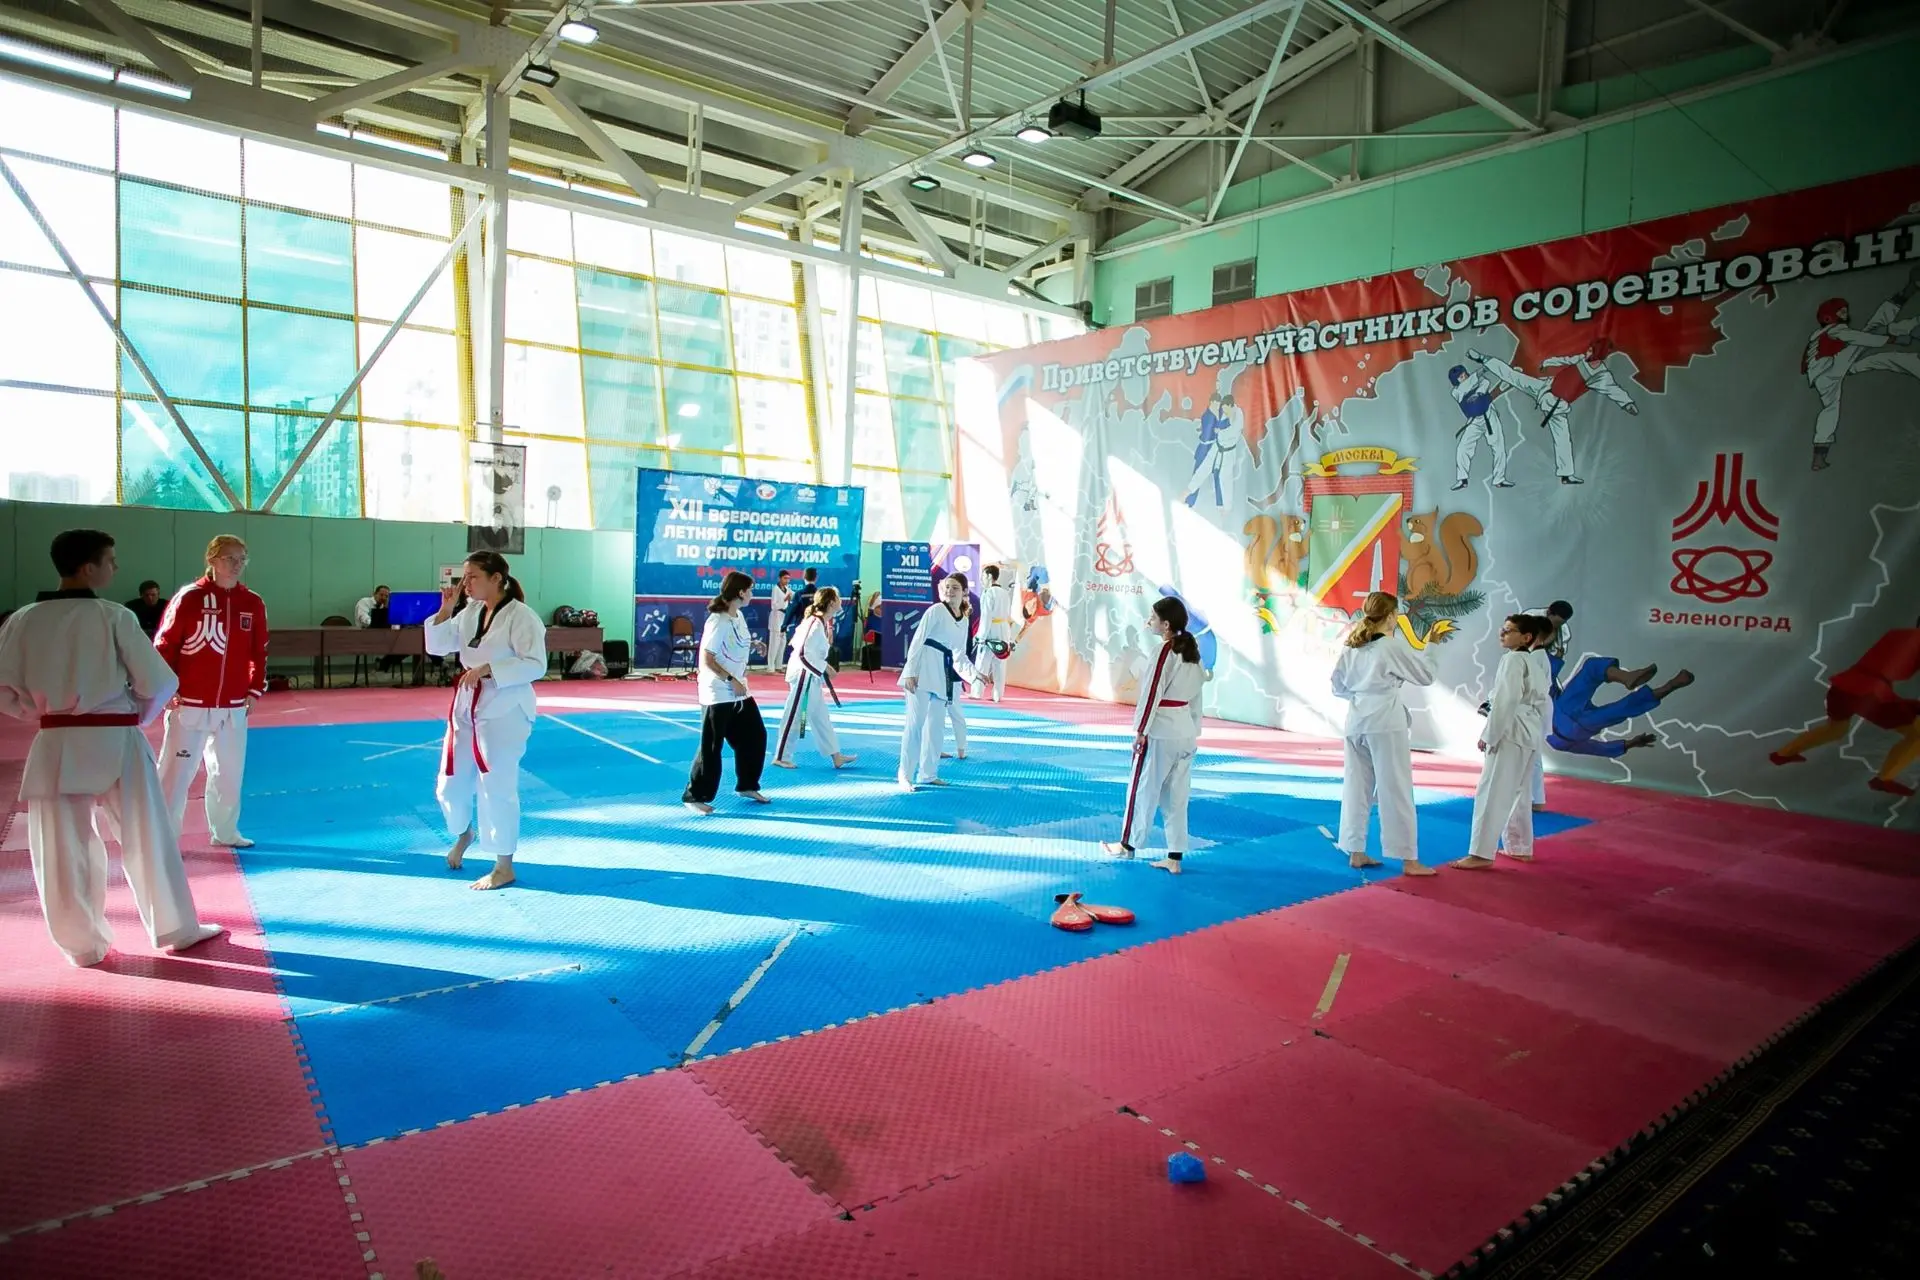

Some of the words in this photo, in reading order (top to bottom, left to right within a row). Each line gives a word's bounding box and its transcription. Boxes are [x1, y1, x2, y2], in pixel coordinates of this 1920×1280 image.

[1041, 336, 1247, 393] Приветствуем
[1254, 297, 1499, 365] участников
[1333, 448, 1385, 464] МОСКВА
[668, 497, 703, 521] XII
[708, 508, 839, 530] ВСЕРОССИЙСКАЯ
[663, 525, 728, 541] ЛЕТНЯЯ
[733, 529, 841, 548] СПАРТАКИАДА
[676, 544, 700, 559] ПО
[705, 545, 768, 562] СПОРТУ
[771, 549, 829, 564] ГЛУХИХ
[901, 555, 919, 567] XII
[1086, 580, 1144, 595] Зеленоград
[1648, 608, 1792, 632] Зеленоград
